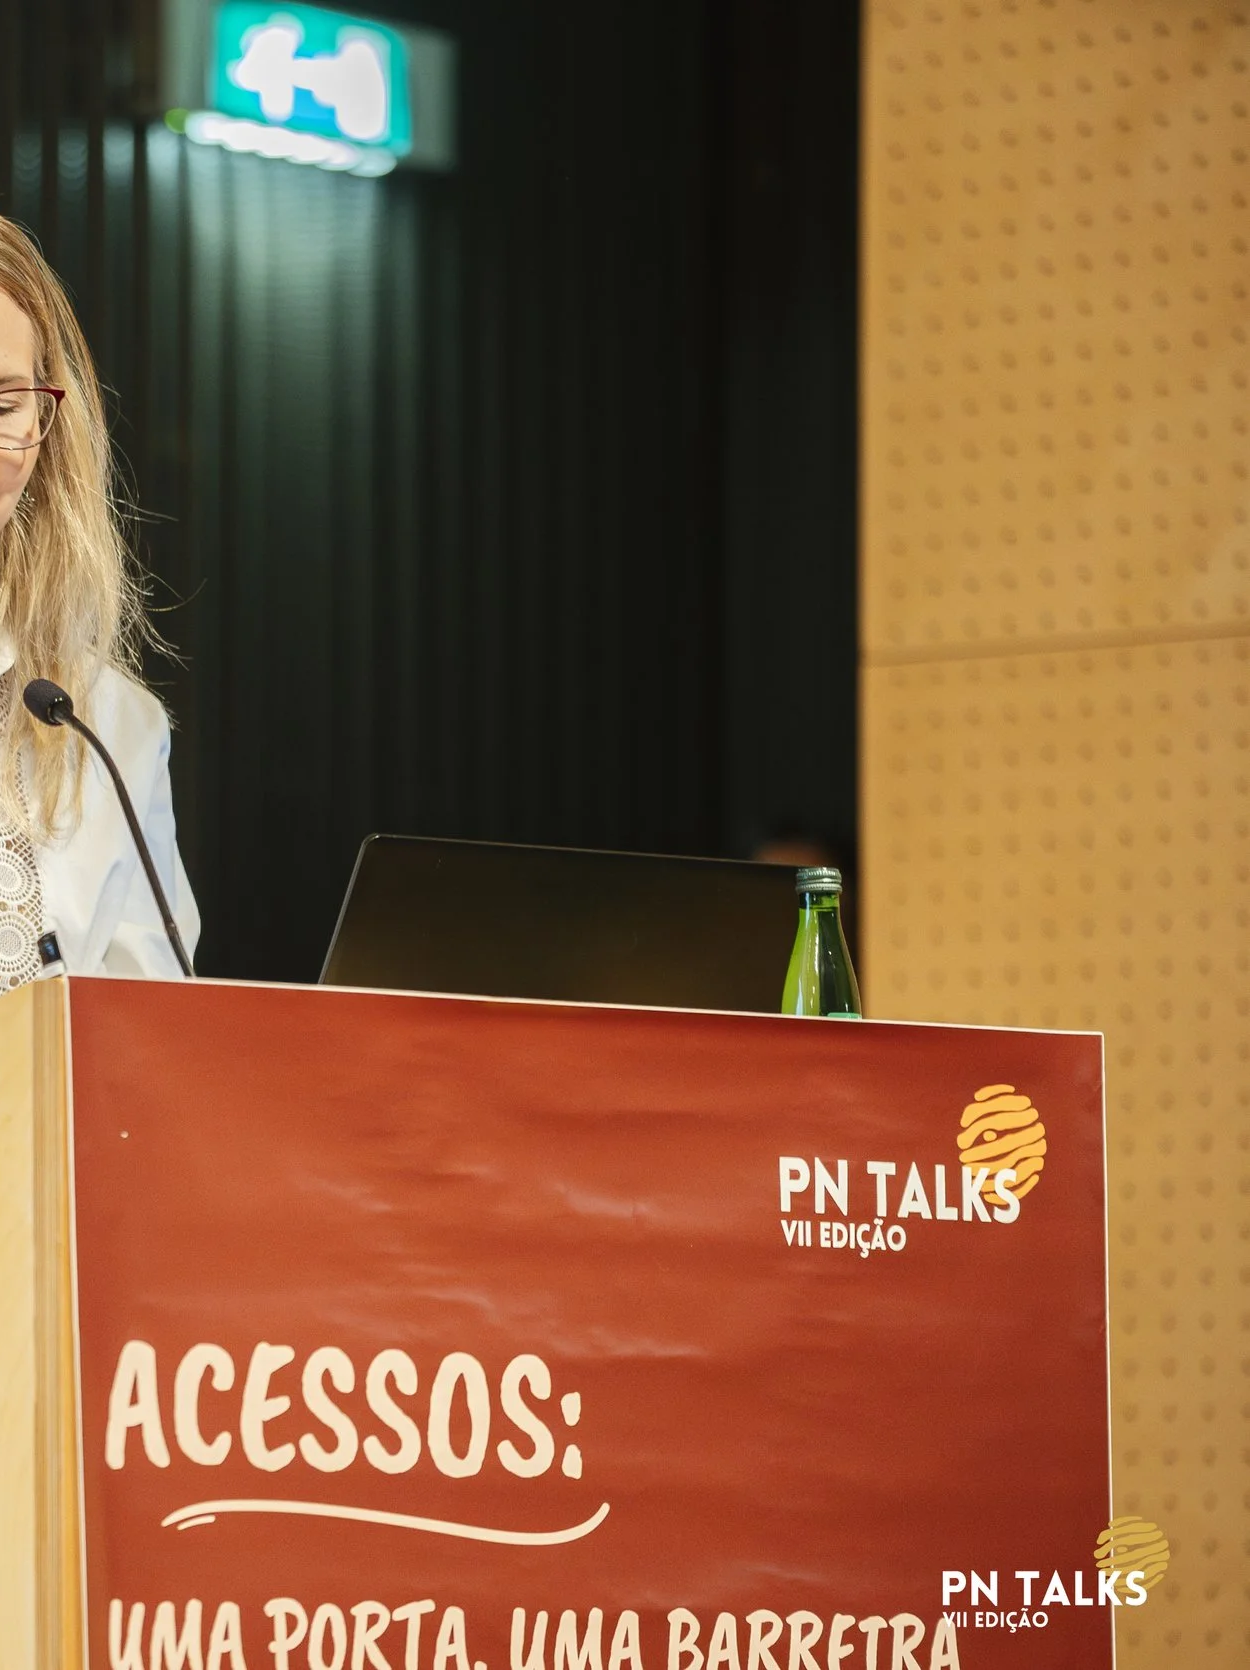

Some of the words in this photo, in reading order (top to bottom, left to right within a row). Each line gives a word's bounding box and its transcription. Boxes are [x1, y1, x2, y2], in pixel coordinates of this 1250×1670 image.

[779, 1156, 849, 1217] PN
[866, 1160, 1021, 1224] TALKS
[780, 1219, 812, 1248] VII
[819, 1217, 907, 1259] EDIÇÃO
[105, 1339, 583, 1480] ACESSOS:
[108, 1598, 247, 1670] UMA
[510, 1606, 644, 1670] UMA
